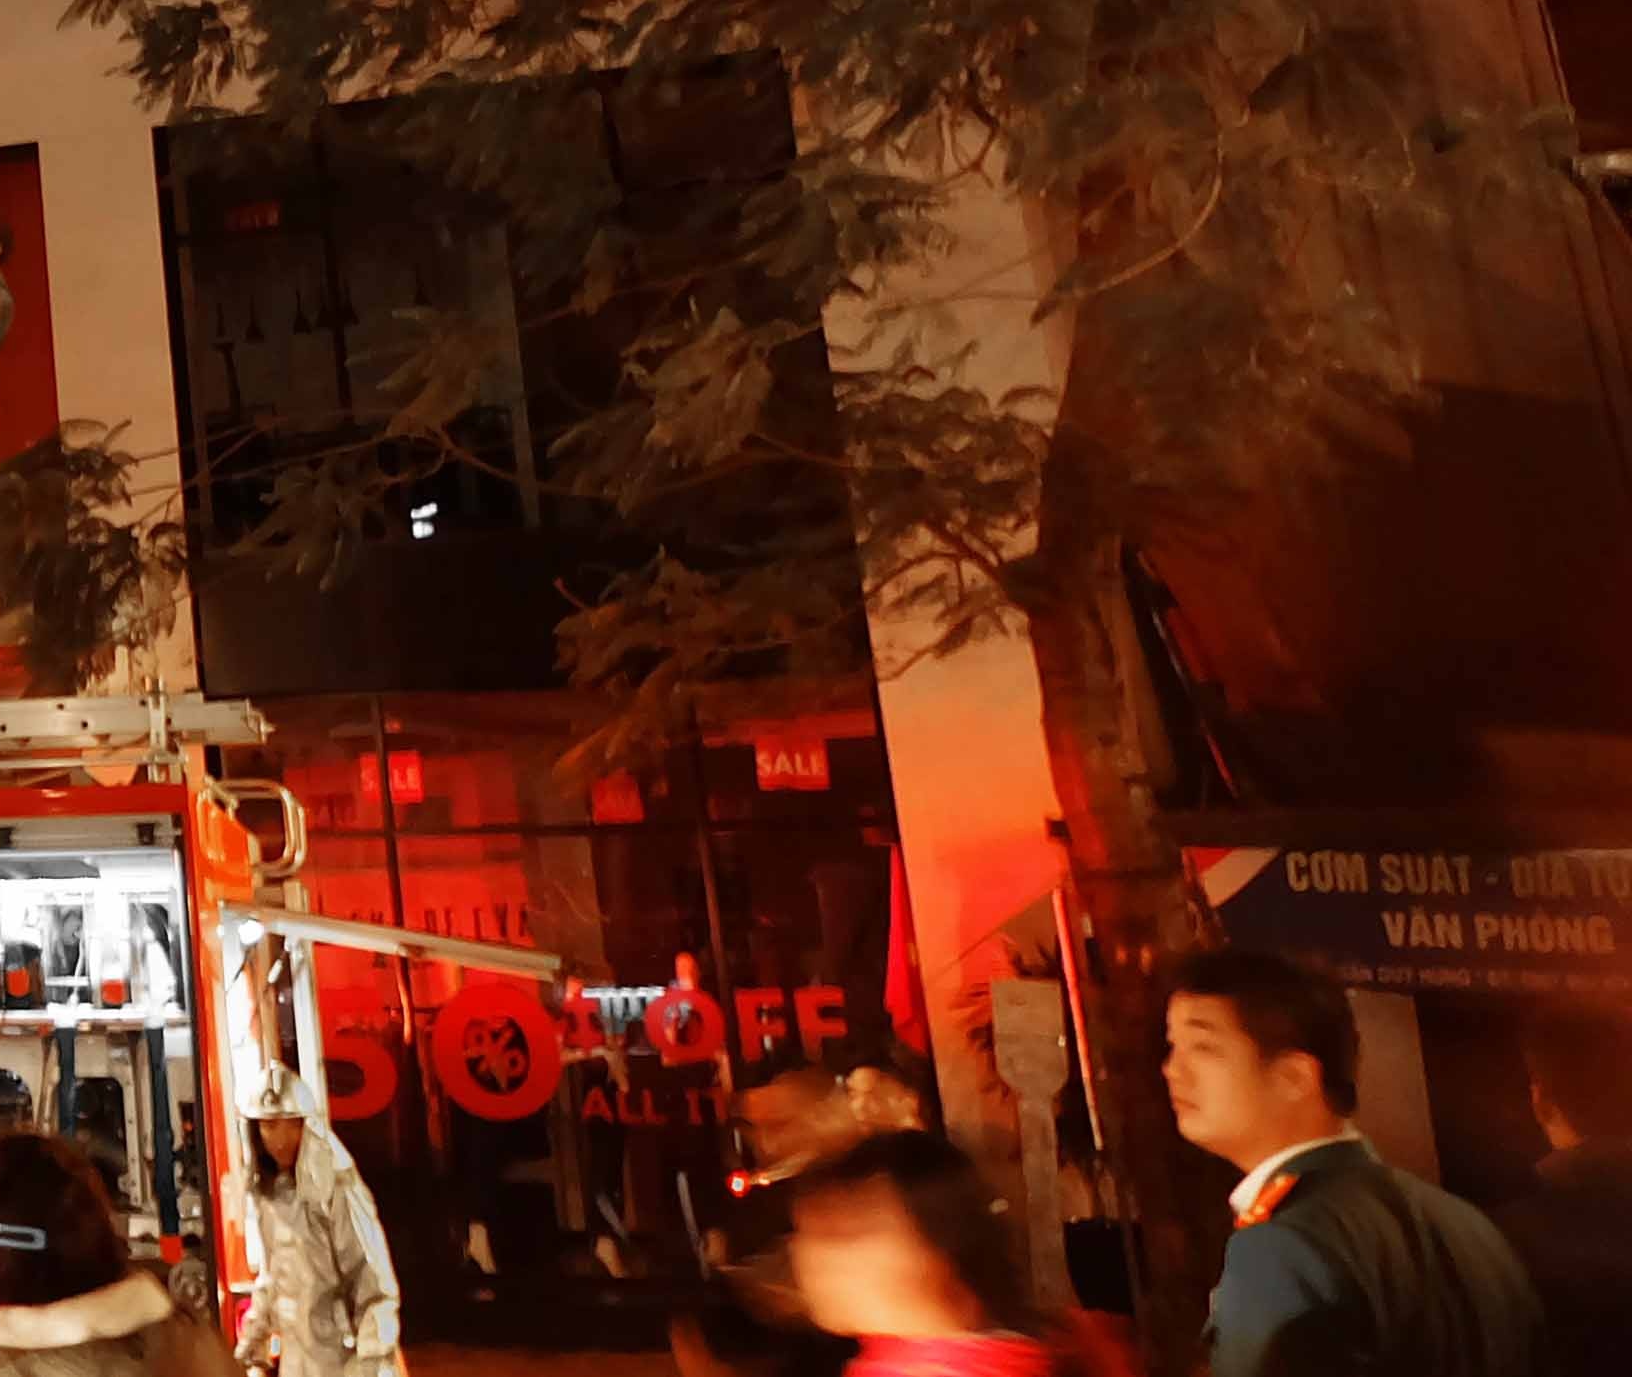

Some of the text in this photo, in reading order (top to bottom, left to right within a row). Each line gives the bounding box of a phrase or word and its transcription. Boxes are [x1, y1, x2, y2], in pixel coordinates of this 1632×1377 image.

[756, 751, 824, 776] SALE
[361, 766, 420, 791] SLE
[581, 1086, 670, 1124] ALL
